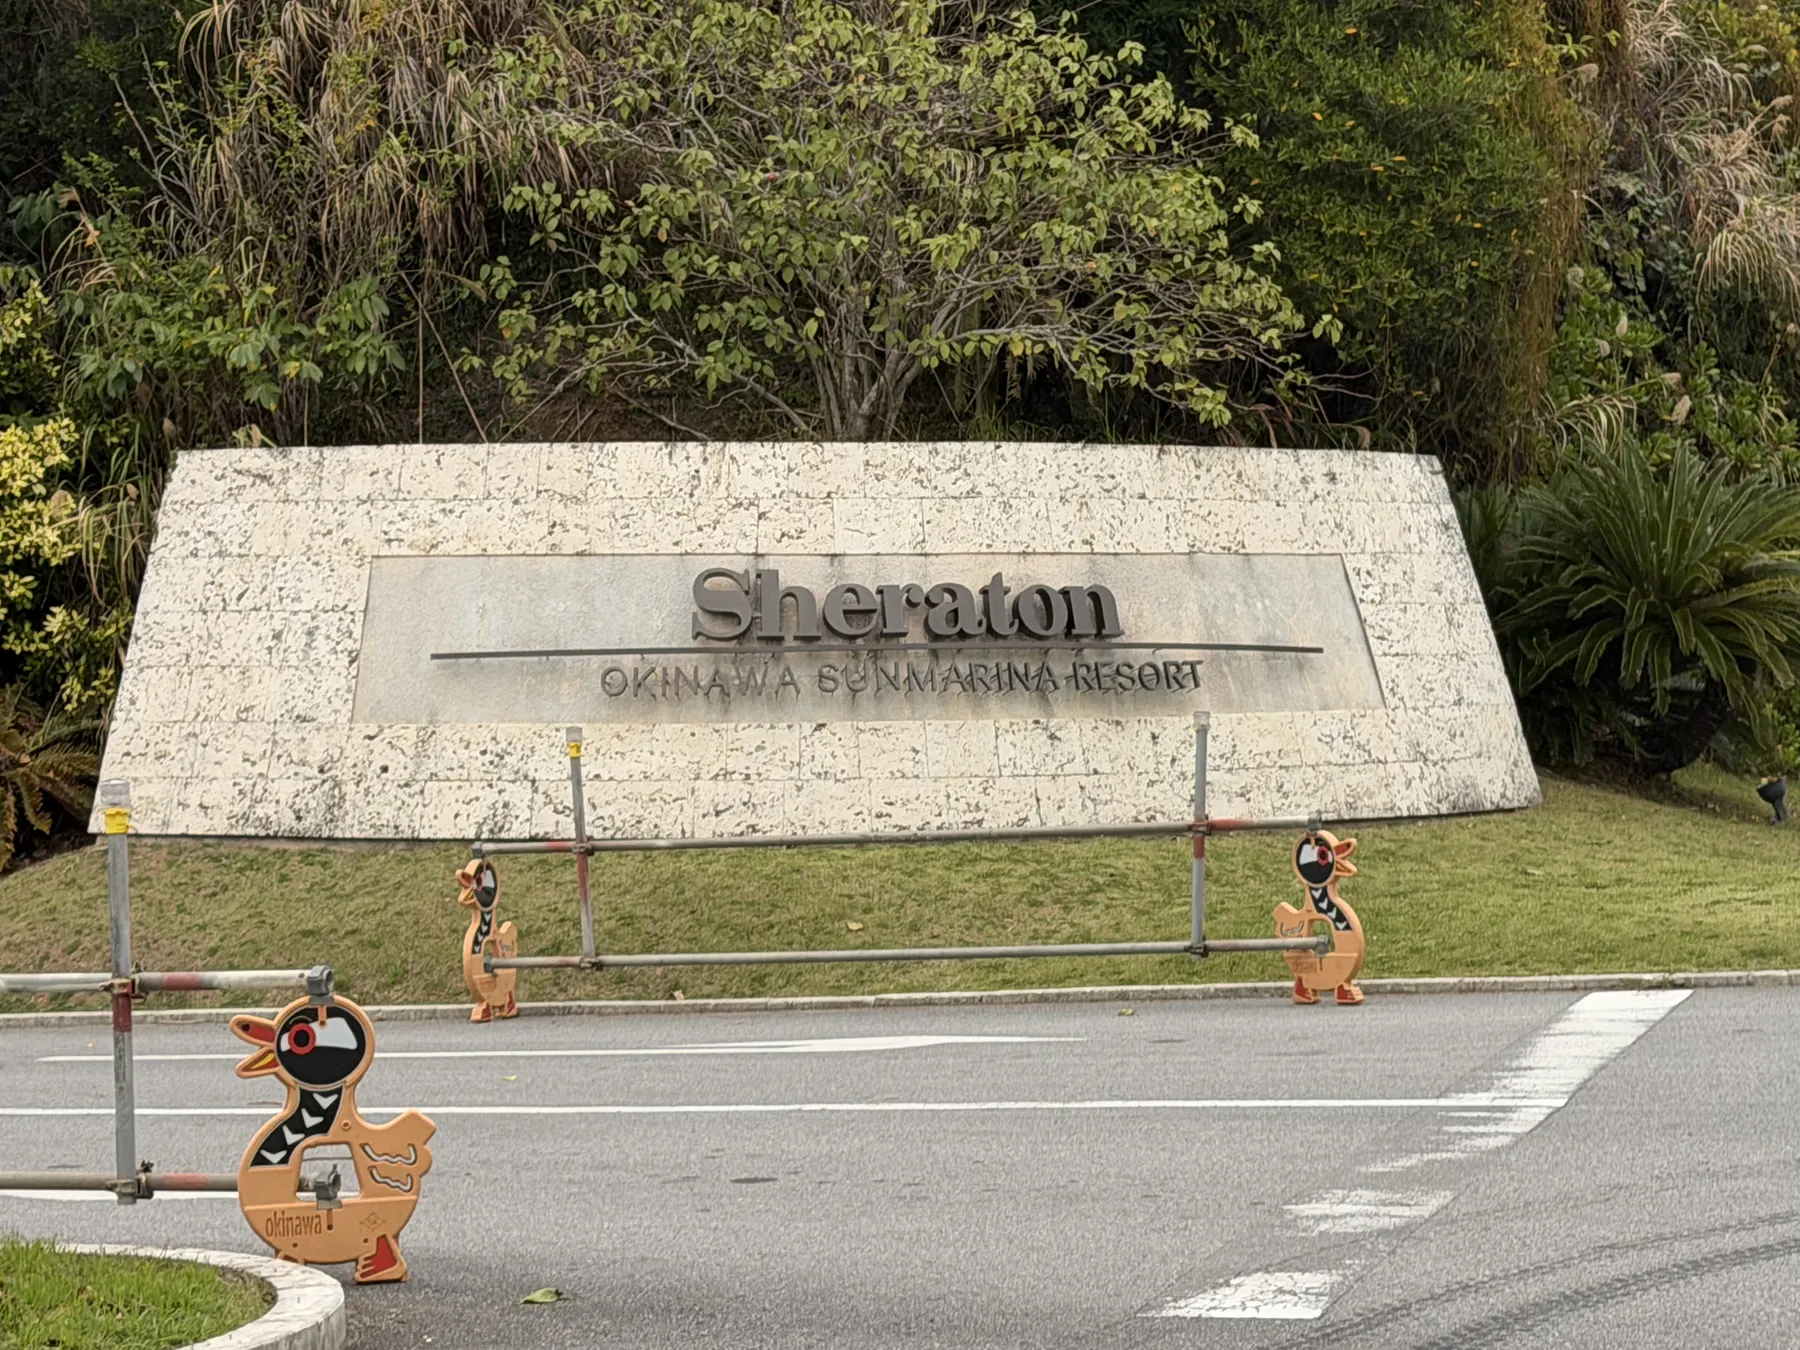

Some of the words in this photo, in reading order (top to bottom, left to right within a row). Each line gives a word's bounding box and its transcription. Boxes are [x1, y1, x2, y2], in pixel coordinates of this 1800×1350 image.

[691, 567, 1123, 641] Sheraton
[601, 664, 800, 697] OKINAWA
[817, 660, 1060, 693] SUNMARINA
[1068, 660, 1204, 692] RESORT
[265, 1210, 322, 1238] okinawa
